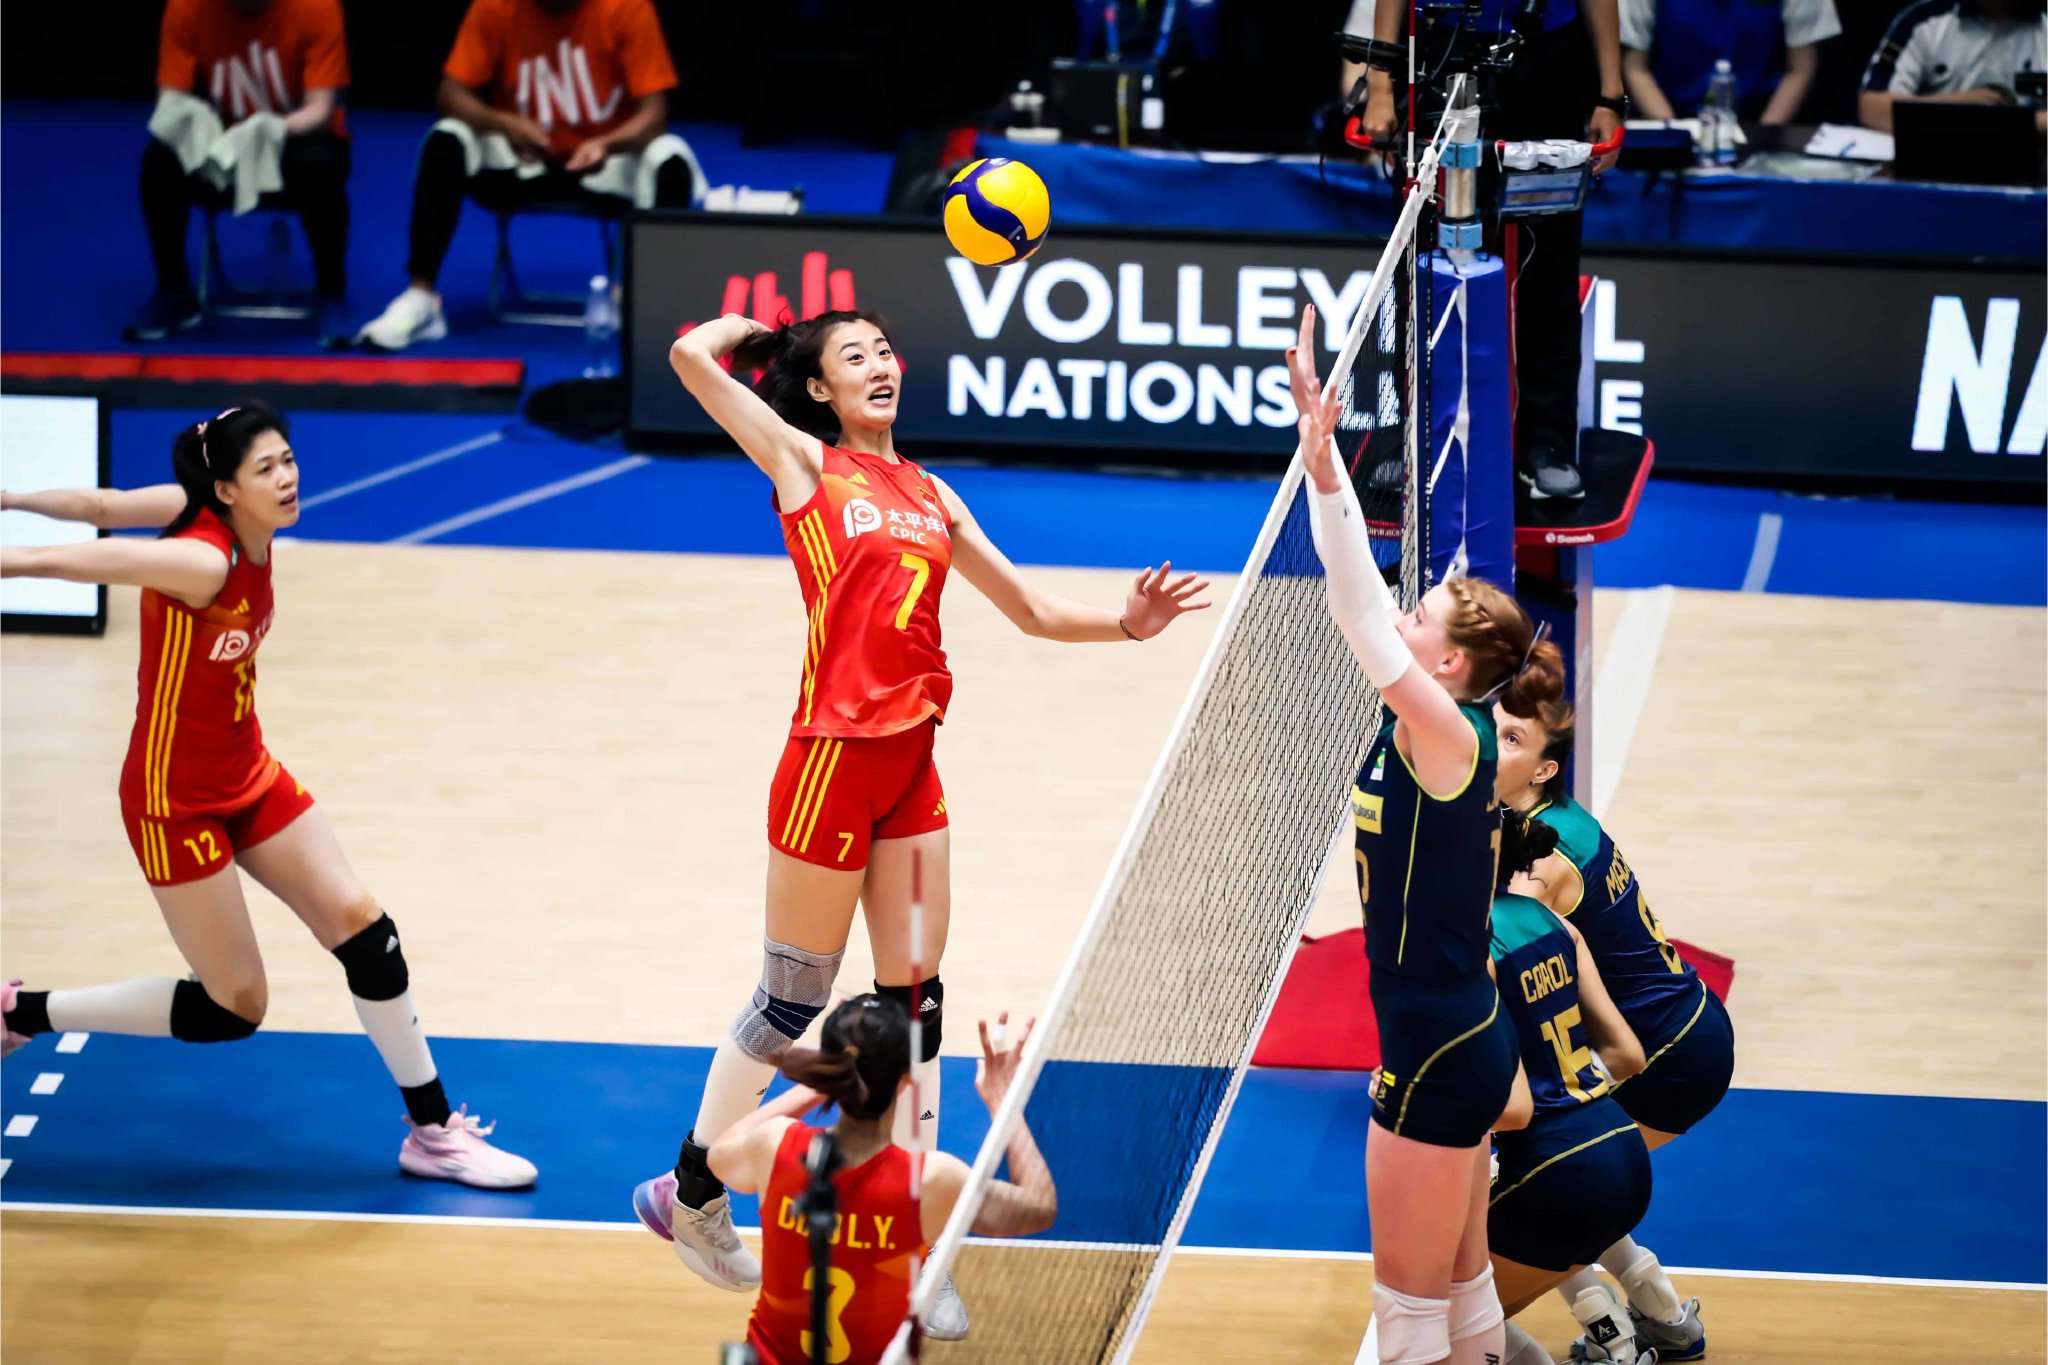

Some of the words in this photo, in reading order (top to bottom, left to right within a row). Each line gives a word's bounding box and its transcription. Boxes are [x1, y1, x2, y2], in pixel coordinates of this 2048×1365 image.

[947, 354, 1300, 429] NATIONS
[889, 525, 927, 545] CPIC
[1557, 532, 1595, 544] Senoh
[895, 551, 930, 630] 7
[183, 829, 222, 866] 12
[837, 831, 854, 863] 7
[1520, 952, 1574, 1005] CAROL
[1539, 1002, 1610, 1104] 15
[800, 1265, 856, 1365] 3
